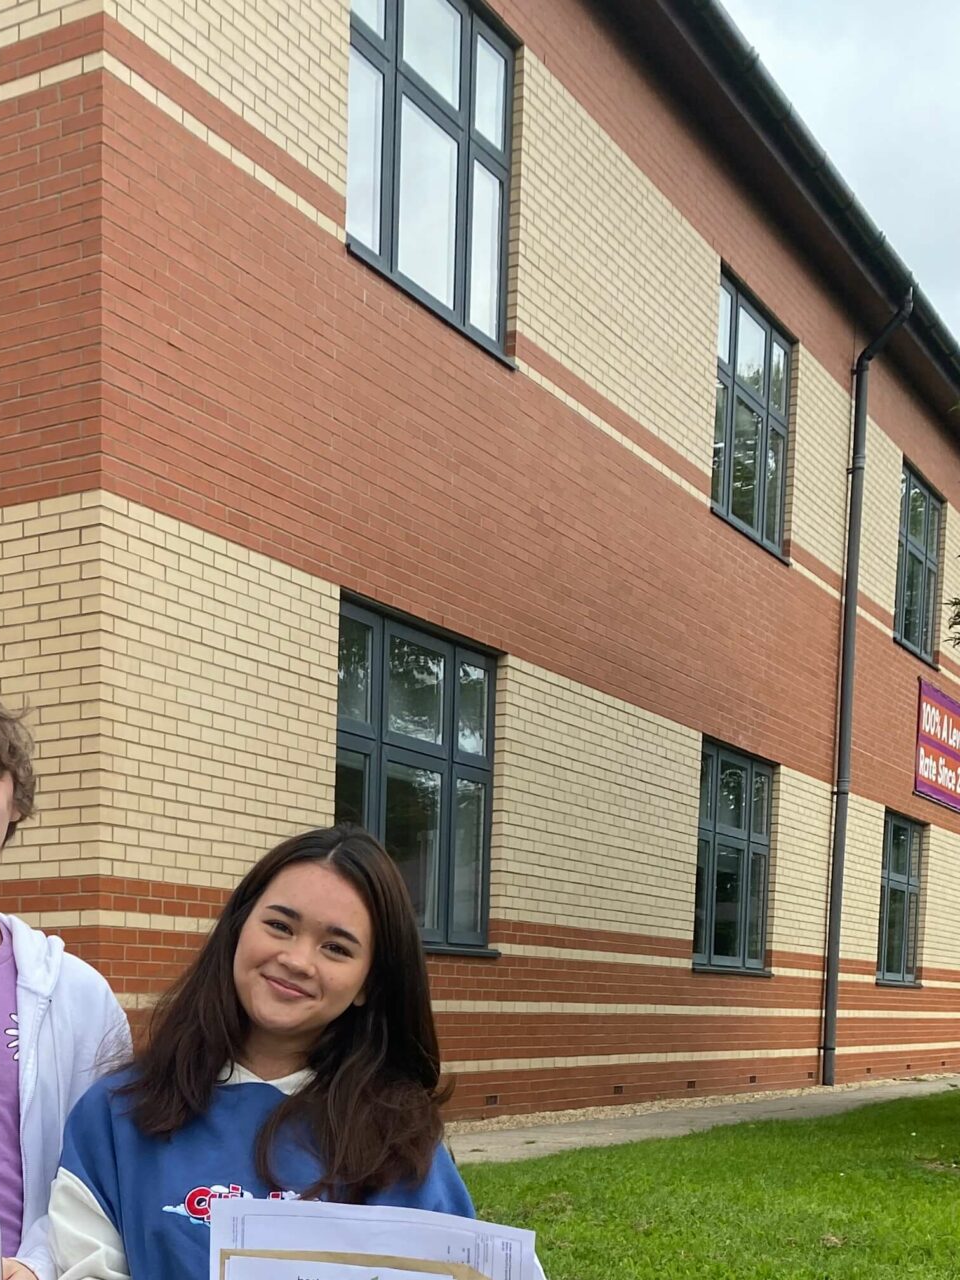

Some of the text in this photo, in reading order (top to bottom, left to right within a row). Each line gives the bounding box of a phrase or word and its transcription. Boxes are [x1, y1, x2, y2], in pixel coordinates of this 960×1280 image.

[922, 702, 941, 739] 100%
[941, 714, 948, 743] A
[919, 746, 936, 782] Rate
[937, 756, 956, 791] Since
